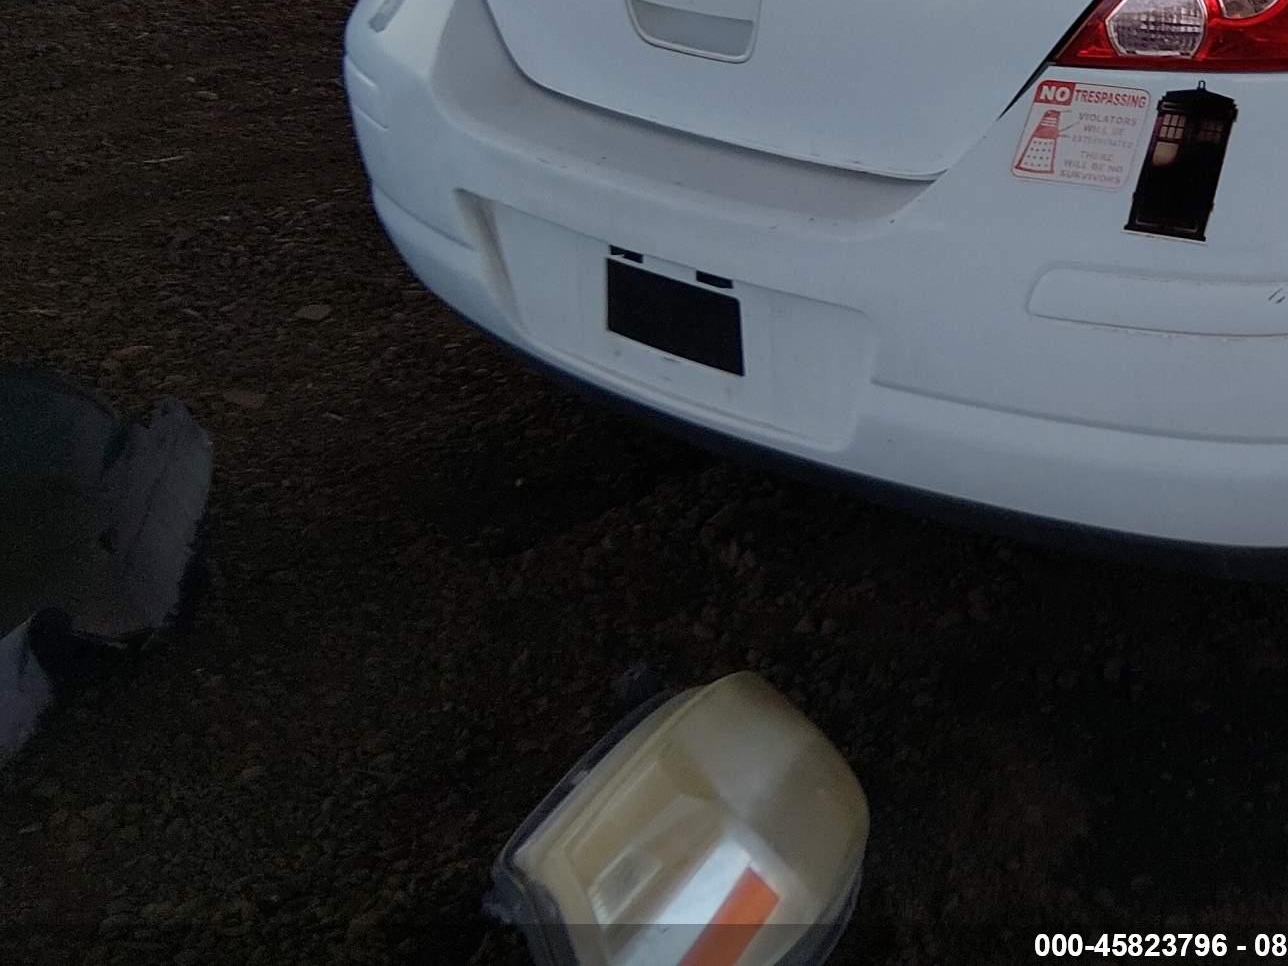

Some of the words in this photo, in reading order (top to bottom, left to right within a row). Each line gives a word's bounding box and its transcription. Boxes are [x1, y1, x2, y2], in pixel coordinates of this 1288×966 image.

[1039, 85, 1072, 102] NO
[1075, 89, 1147, 109] TRESPASSING
[1079, 112, 1137, 126] VIOLATORS
